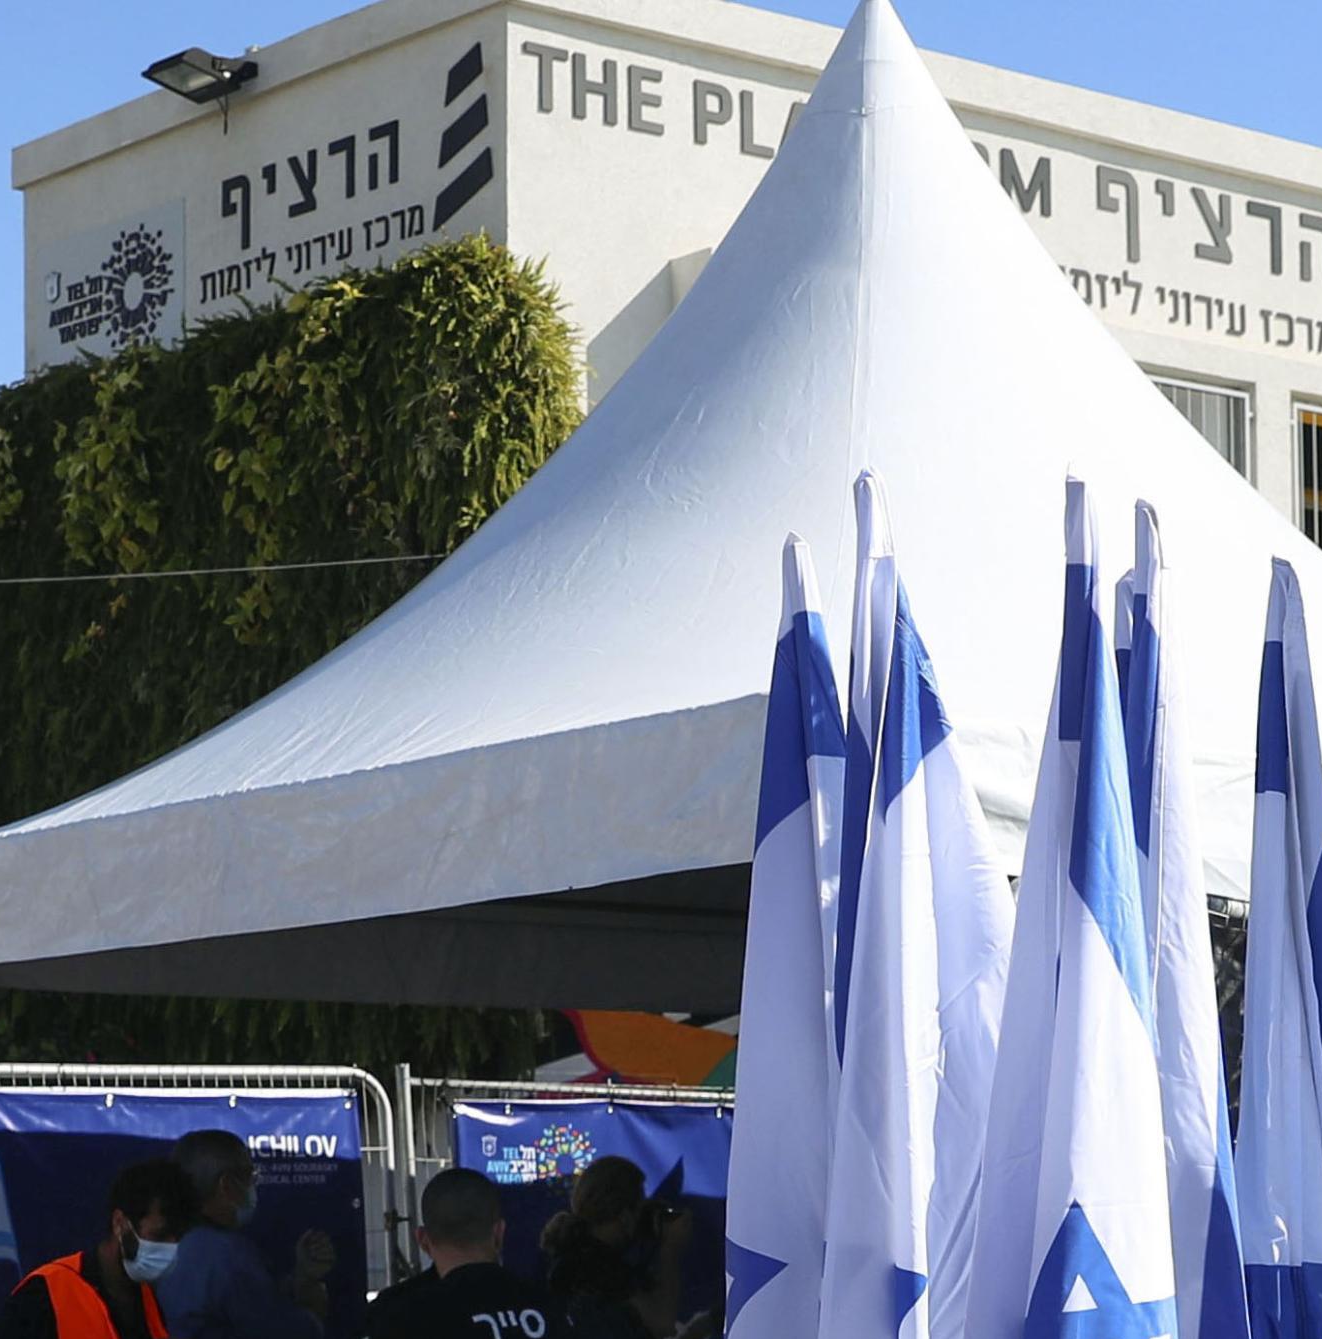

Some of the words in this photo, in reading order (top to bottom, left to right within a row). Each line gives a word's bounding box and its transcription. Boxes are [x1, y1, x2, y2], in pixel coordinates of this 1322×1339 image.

[521, 41, 665, 137] THE
[221, 119, 400, 251] הרציף
[286, 226, 353, 276] עירוני
[362, 204, 425, 252] מרכז
[1060, 269, 1143, 316] ליזמ
[1155, 286, 1246, 337] עירוני
[248, 1135, 338, 1158] ICHILOV
